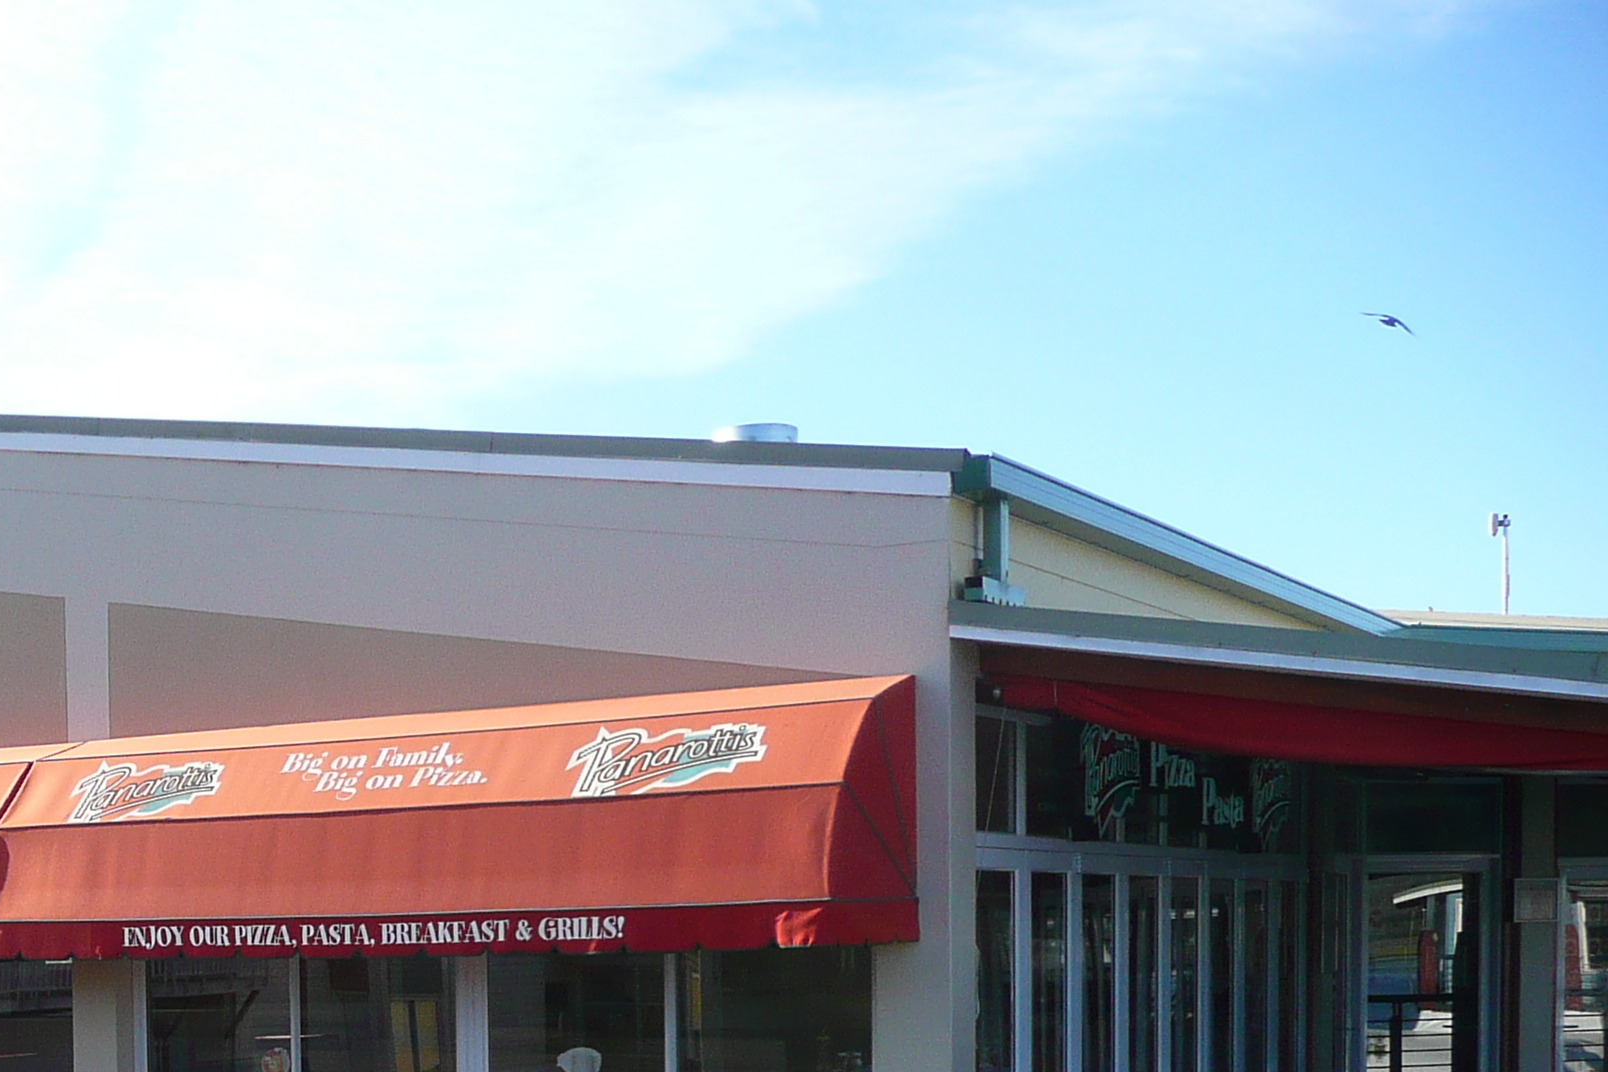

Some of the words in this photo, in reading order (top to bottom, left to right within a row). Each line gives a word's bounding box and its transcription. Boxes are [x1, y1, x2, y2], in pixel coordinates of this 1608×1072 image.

[280, 752, 328, 781] Big
[331, 753, 367, 769] on
[313, 771, 363, 800] Big
[366, 774, 404, 789] on
[409, 766, 487, 787] Pizza.
[577, 724, 760, 796] Panarottis
[1150, 741, 1196, 789] Pizza
[73, 763, 217, 821] Panarottis
[1202, 777, 1243, 828] Pasta
[122, 925, 185, 949] ENJOY
[189, 926, 230, 947] OUR
[234, 925, 297, 949] PIZZA,
[300, 923, 375, 948] PASTA,
[381, 920, 510, 945] BREAKFAST
[515, 920, 532, 942] &
[538, 915, 624, 941] GRILLS!
